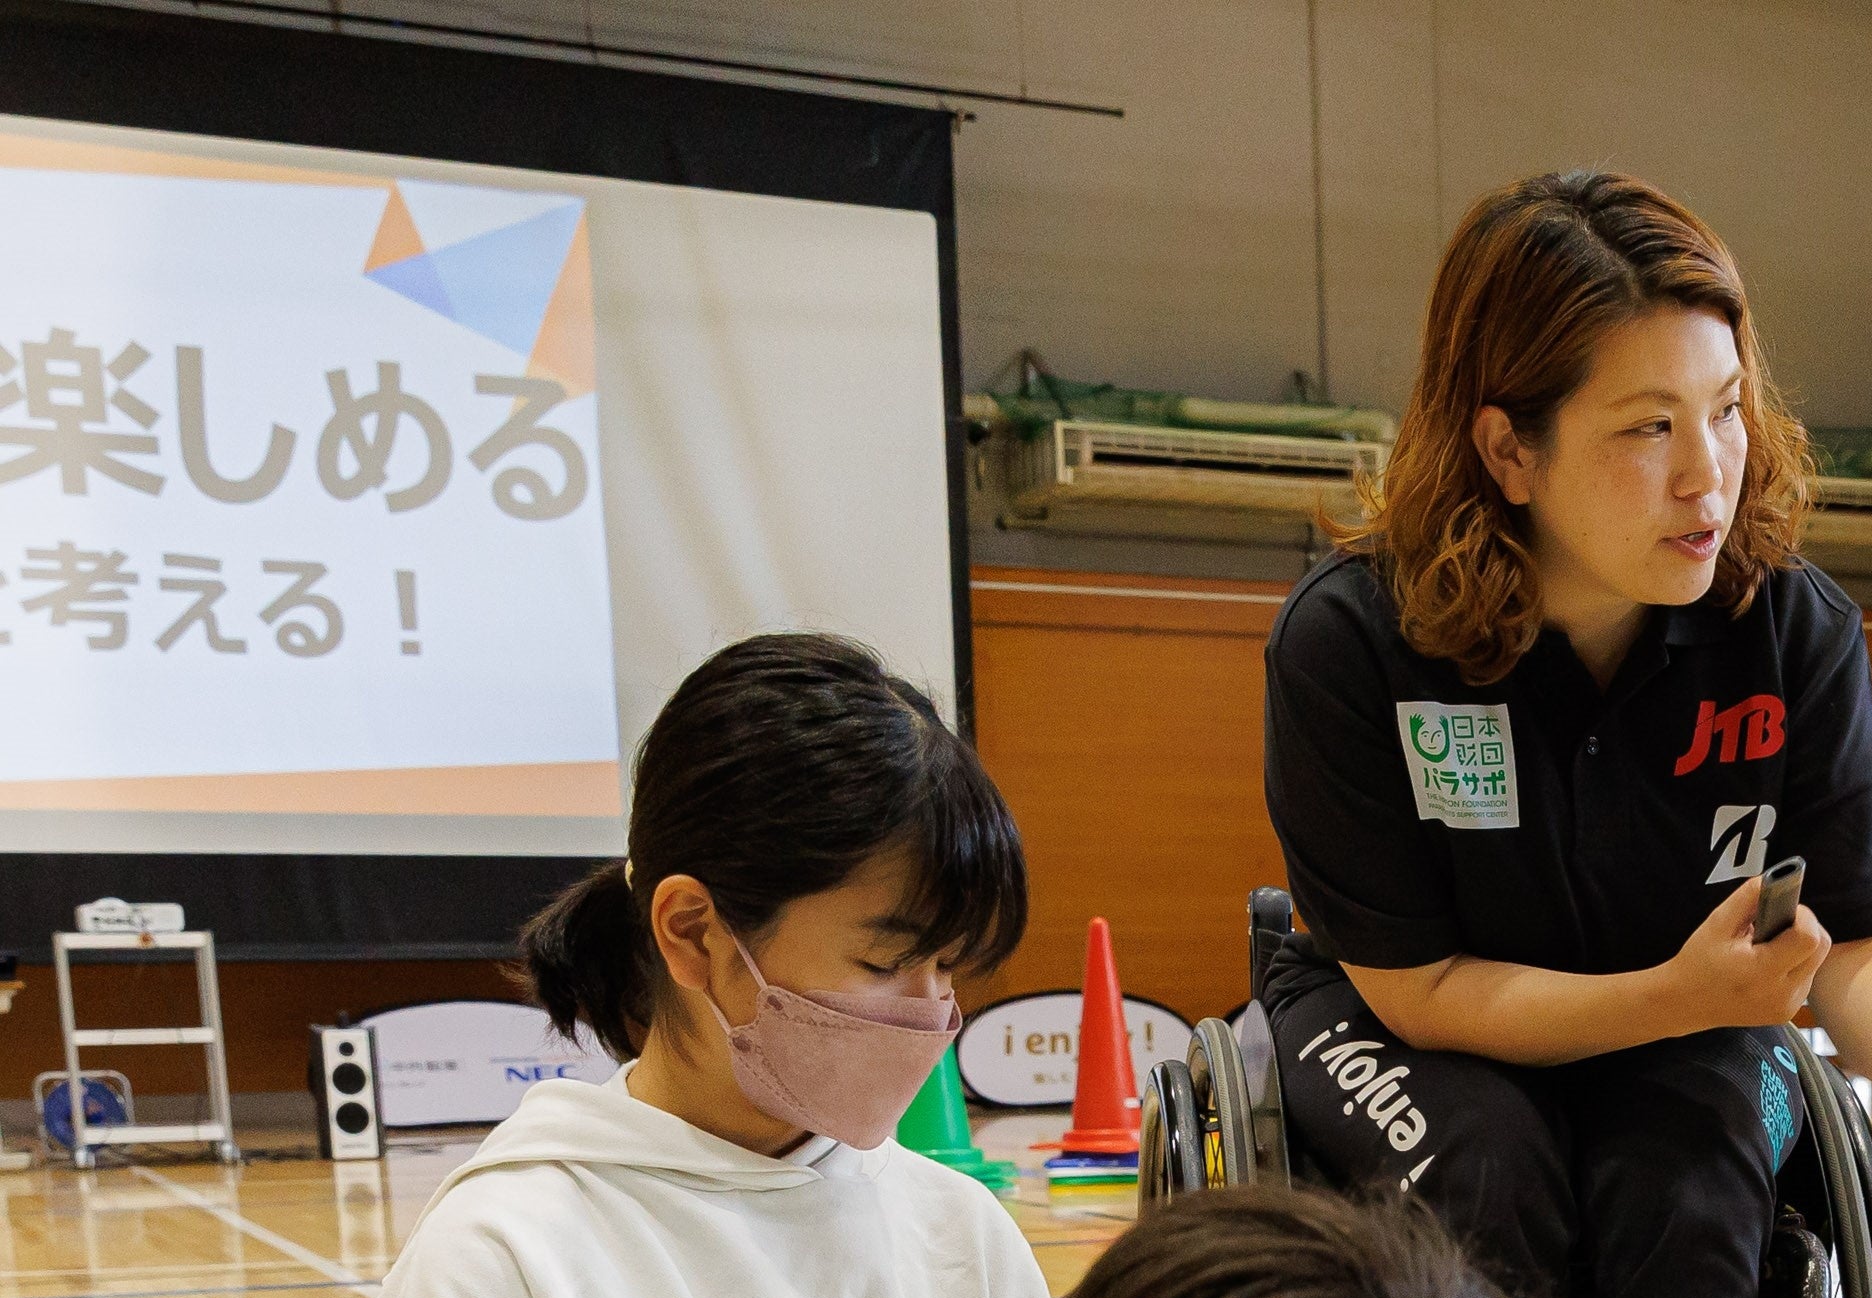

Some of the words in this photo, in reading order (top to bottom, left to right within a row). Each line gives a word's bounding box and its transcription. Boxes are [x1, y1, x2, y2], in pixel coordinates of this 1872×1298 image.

[0, 327, 588, 521] 楽しめる
[0, 541, 422, 658] 考える！
[1451, 715, 1502, 739] 日本
[1674, 695, 1786, 776] JTB
[1423, 767, 1506, 795] パラサポ
[1461, 800, 1508, 808] FOUNDATION
[1298, 1021, 1427, 1152] enjoy!
